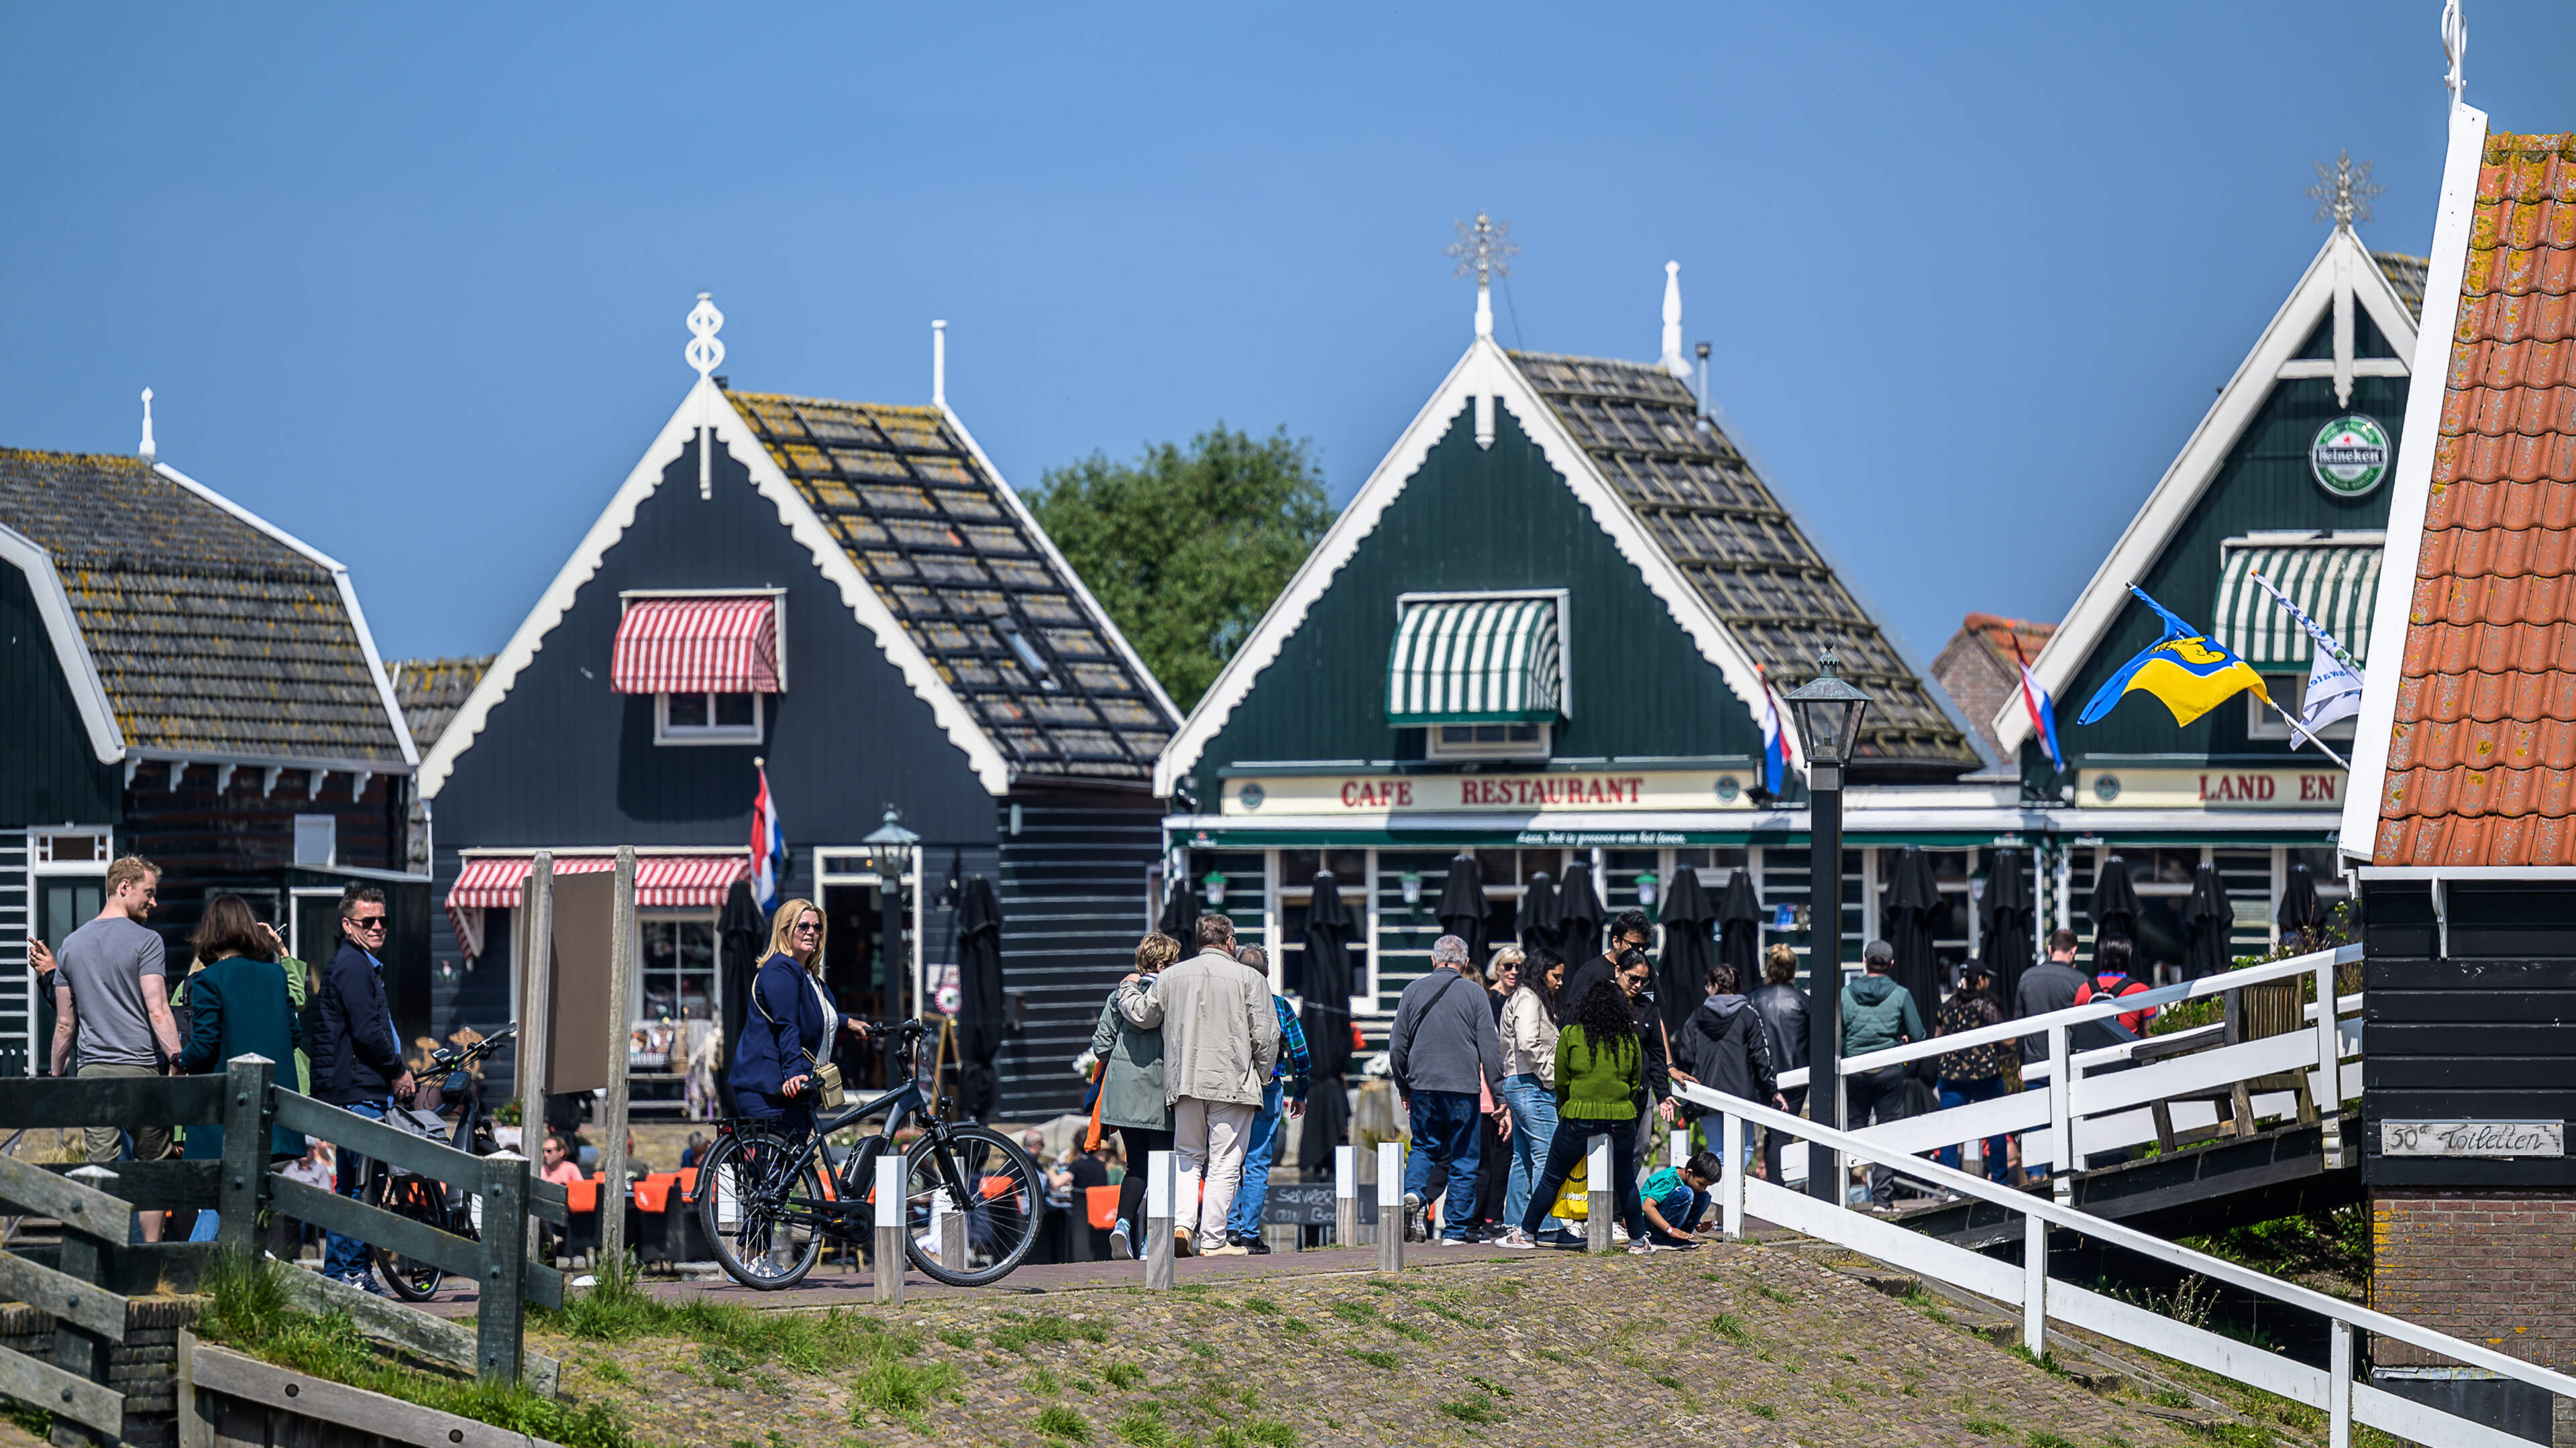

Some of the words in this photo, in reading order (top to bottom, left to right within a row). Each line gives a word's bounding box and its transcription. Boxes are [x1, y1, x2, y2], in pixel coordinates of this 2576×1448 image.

[2318, 447, 2379, 463] Heineken
[1341, 781, 1414, 807] CAFE
[1461, 777, 1645, 805] RESTAURANT
[2198, 774, 2275, 801] LAND
[2300, 774, 2336, 801] EN
[2437, 1124, 2546, 1150] Toiletten
